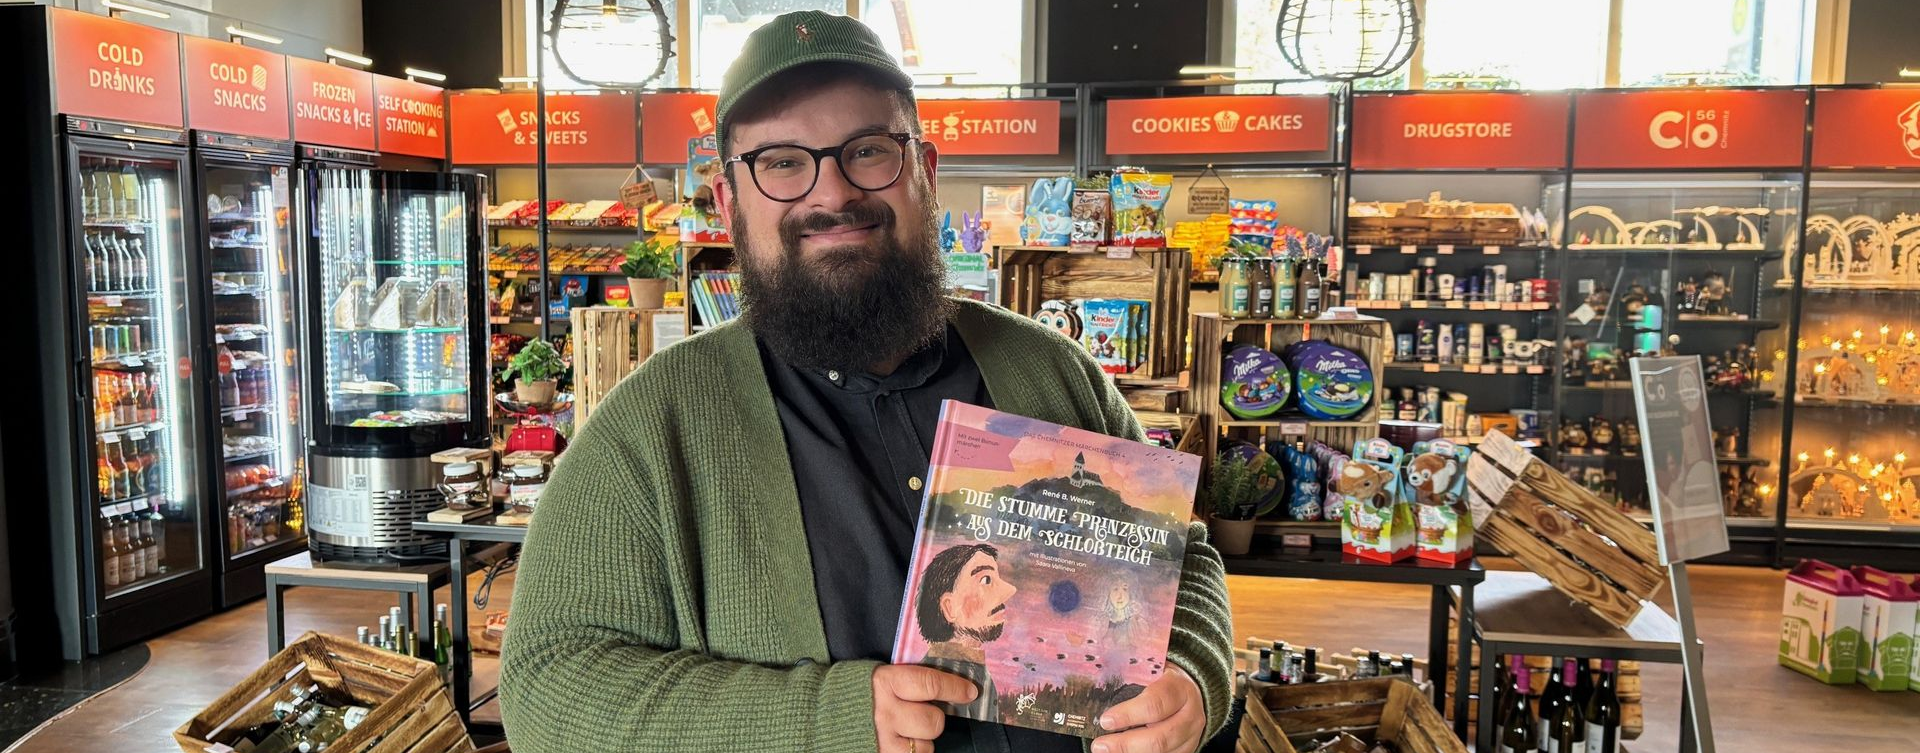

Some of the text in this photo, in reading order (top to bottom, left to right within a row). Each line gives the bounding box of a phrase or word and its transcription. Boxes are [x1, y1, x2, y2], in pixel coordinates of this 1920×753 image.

[97, 41, 144, 67] COLD
[209, 62, 247, 85] COLD
[213, 88, 267, 112] SNACKS
[312, 81, 356, 104] FROZEN
[379, 95, 400, 111] SELF
[296, 102, 341, 123] SNACKS
[343, 111, 352, 125] &
[1131, 116, 1211, 134] COOKIES
[1244, 113, 1304, 131] CAKES
[1696, 109, 1716, 121] 56
[385, 116, 425, 137] STATION
[961, 118, 1038, 135] STATION
[1403, 122, 1513, 139] DRUGSTORE
[513, 130, 526, 145] &
[1233, 357, 1262, 377] Milka
[1315, 358, 1348, 372] Milka
[959, 486, 994, 509] DIE
[997, 495, 1068, 525] STUMME
[1042, 489, 1096, 506] René B. Werner
[965, 513, 992, 541] AUS
[996, 519, 1032, 542] DEM
[1029, 551, 1039, 559] mit
[1040, 553, 1076, 566] Illustrationen
